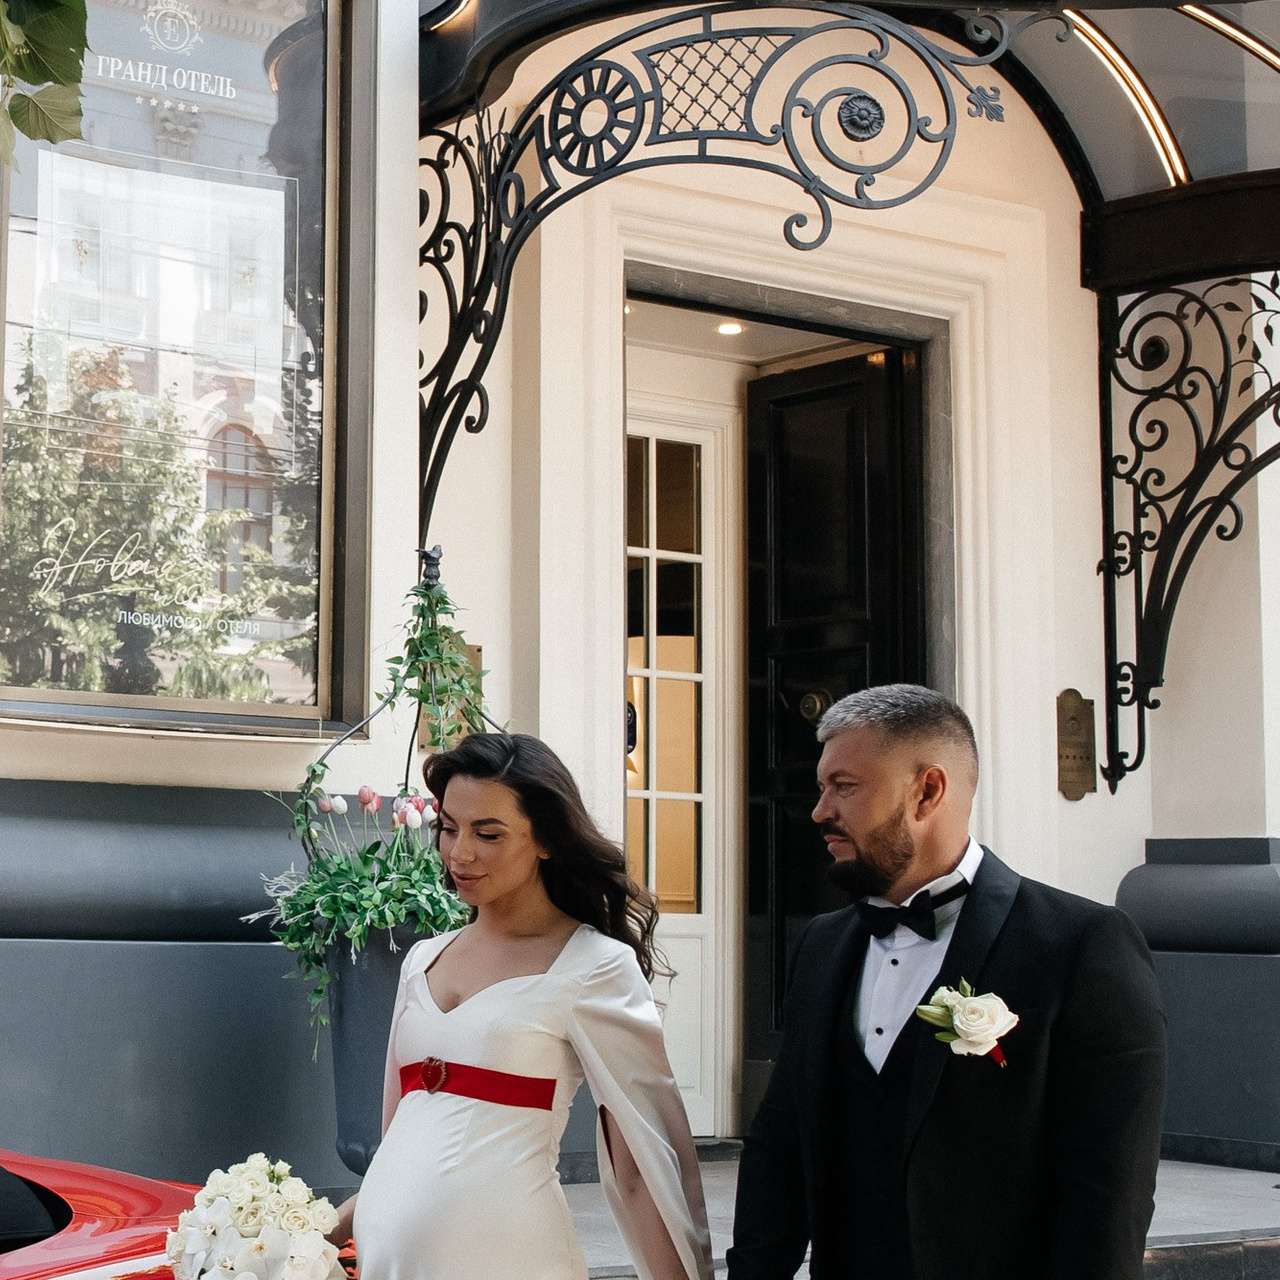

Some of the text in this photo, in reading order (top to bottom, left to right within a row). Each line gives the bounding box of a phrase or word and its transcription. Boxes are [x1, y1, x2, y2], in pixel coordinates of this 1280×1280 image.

[96, 55, 237, 99] ГРАНД ОТЕЛЬ
[117, 610, 261, 635] ЛЮБИМОГО ОТЕЛЯ
